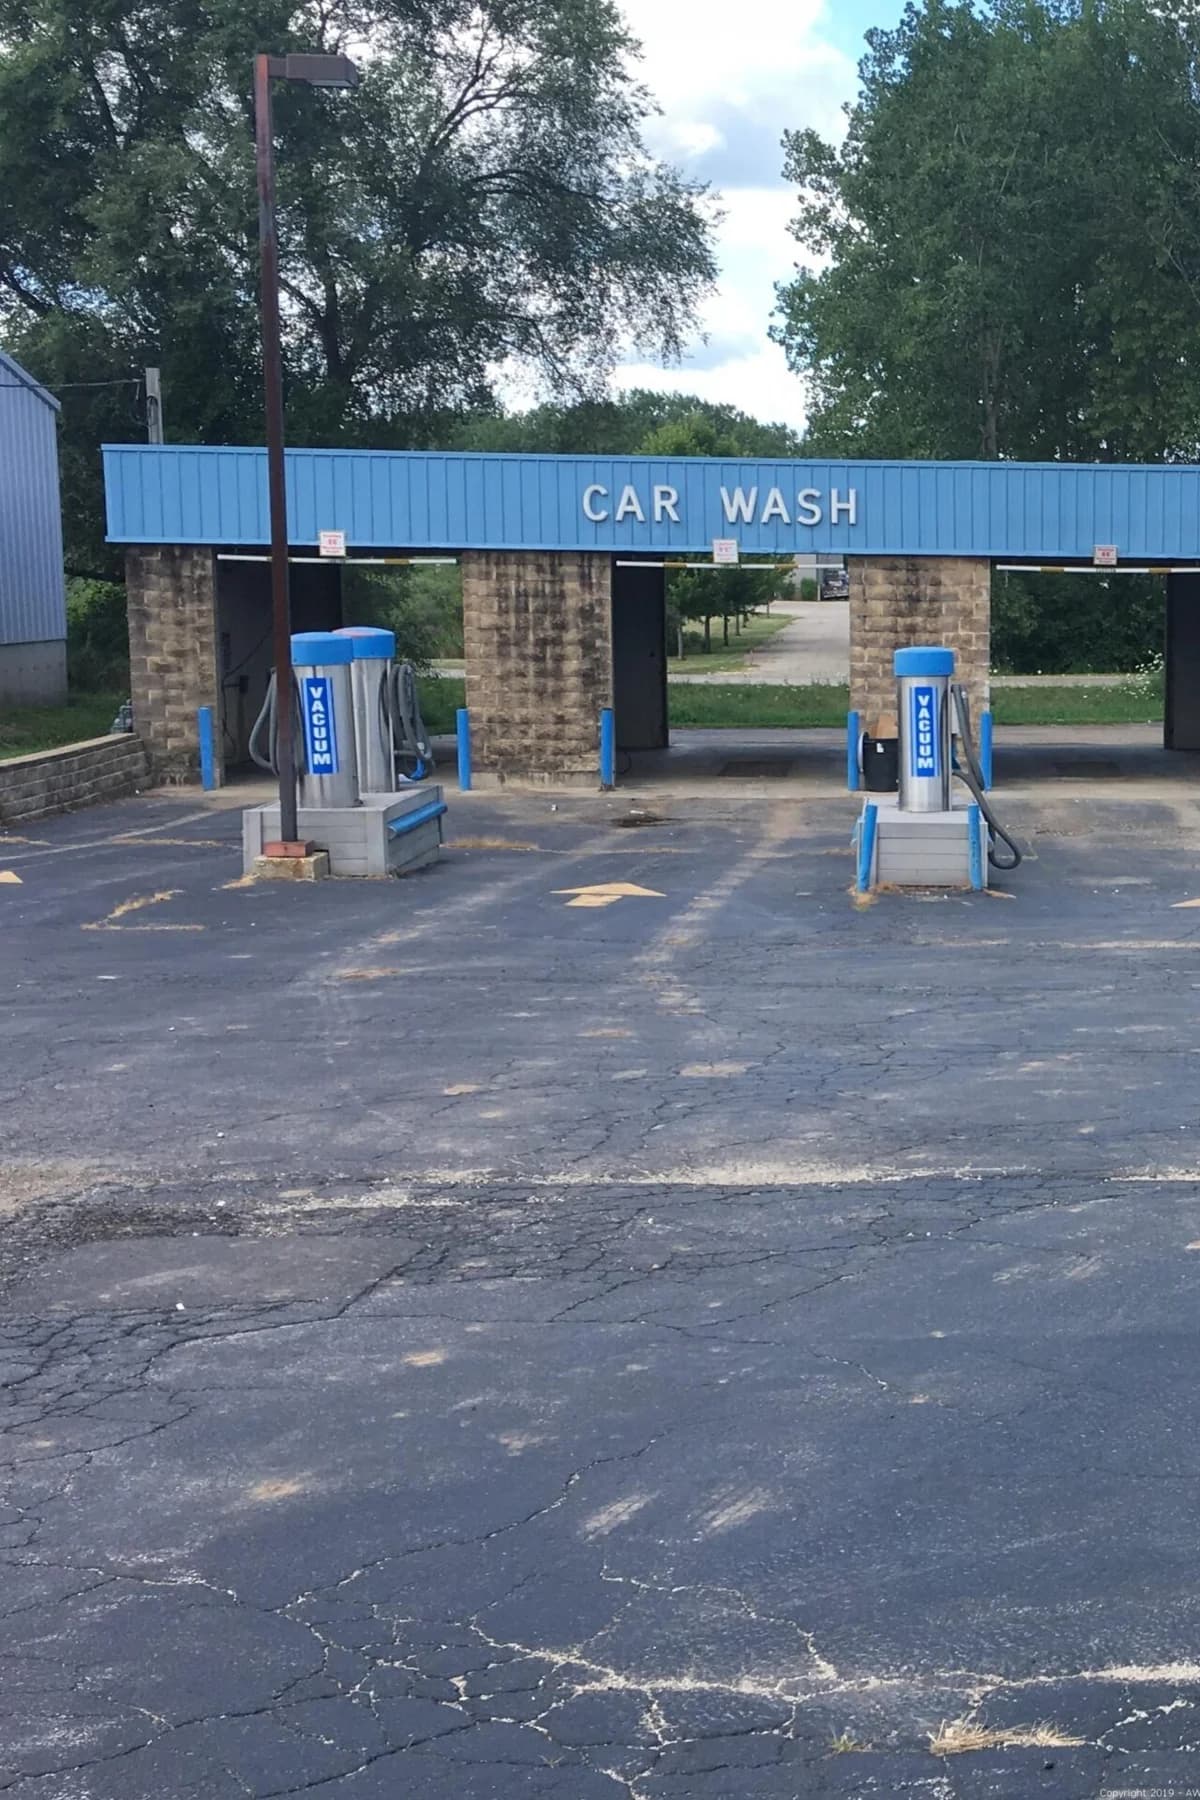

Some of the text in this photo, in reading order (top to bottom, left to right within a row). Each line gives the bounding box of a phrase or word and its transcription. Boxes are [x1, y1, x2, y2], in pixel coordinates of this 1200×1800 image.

[583, 484, 857, 526] CAR WASH
[309, 686, 331, 765] VACUUM
[917, 695, 934, 769] VACUUM
